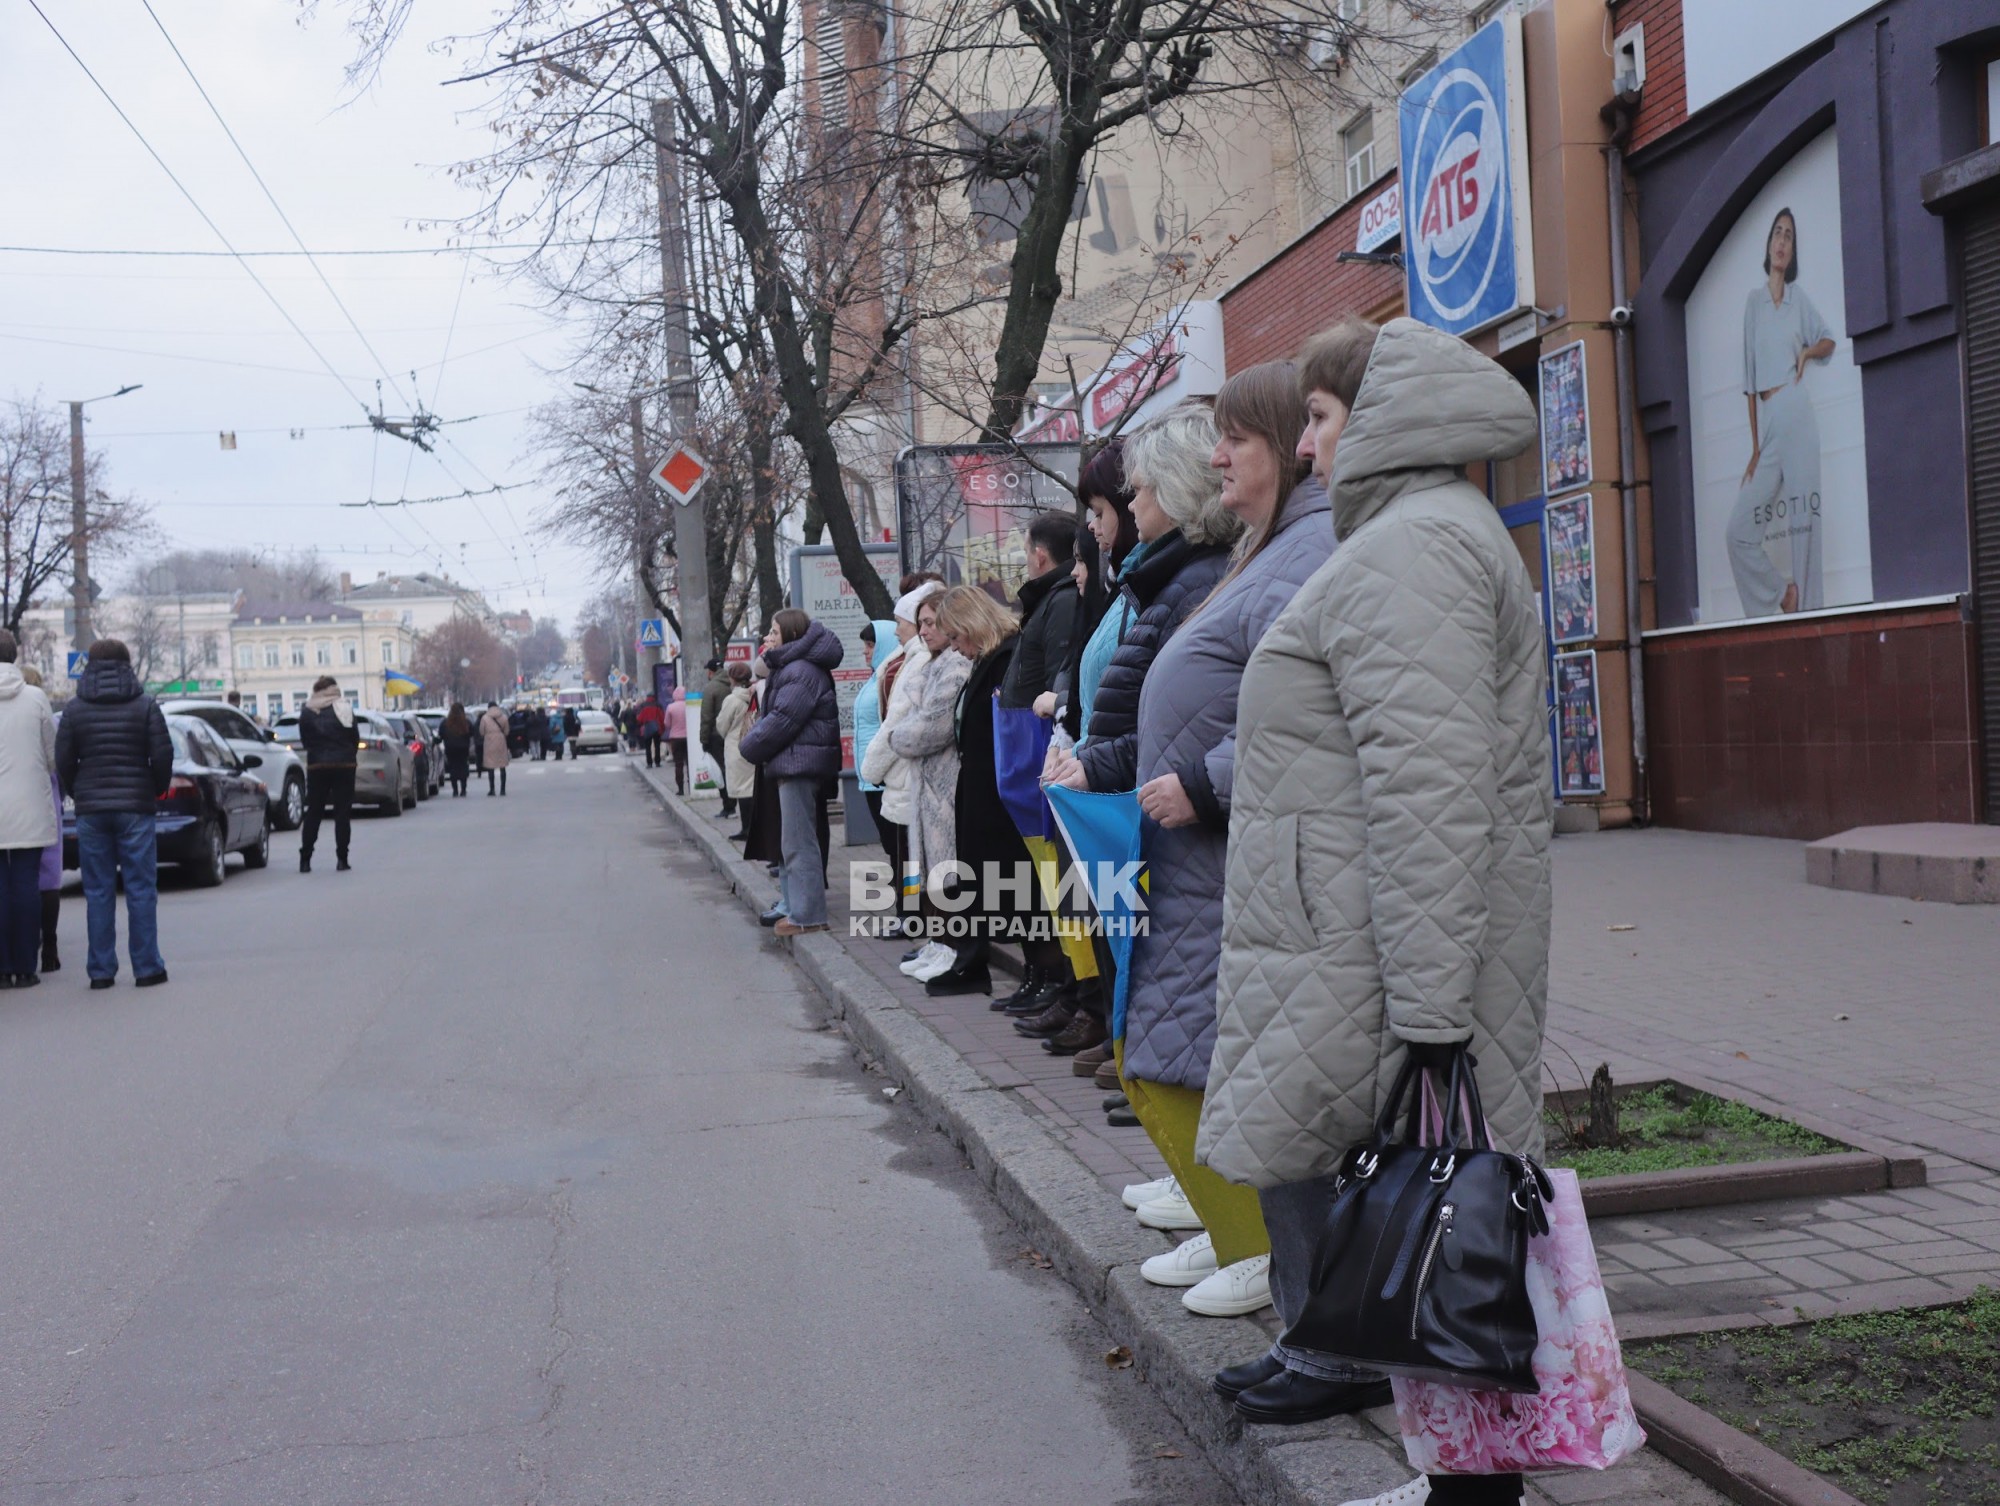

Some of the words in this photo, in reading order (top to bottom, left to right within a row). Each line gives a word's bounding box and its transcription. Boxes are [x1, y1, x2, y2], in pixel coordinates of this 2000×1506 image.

[1365, 191, 1398, 234] 00-2
[1421, 148, 1480, 245] АТБ
[1754, 491, 1821, 525] ESOTIQ
